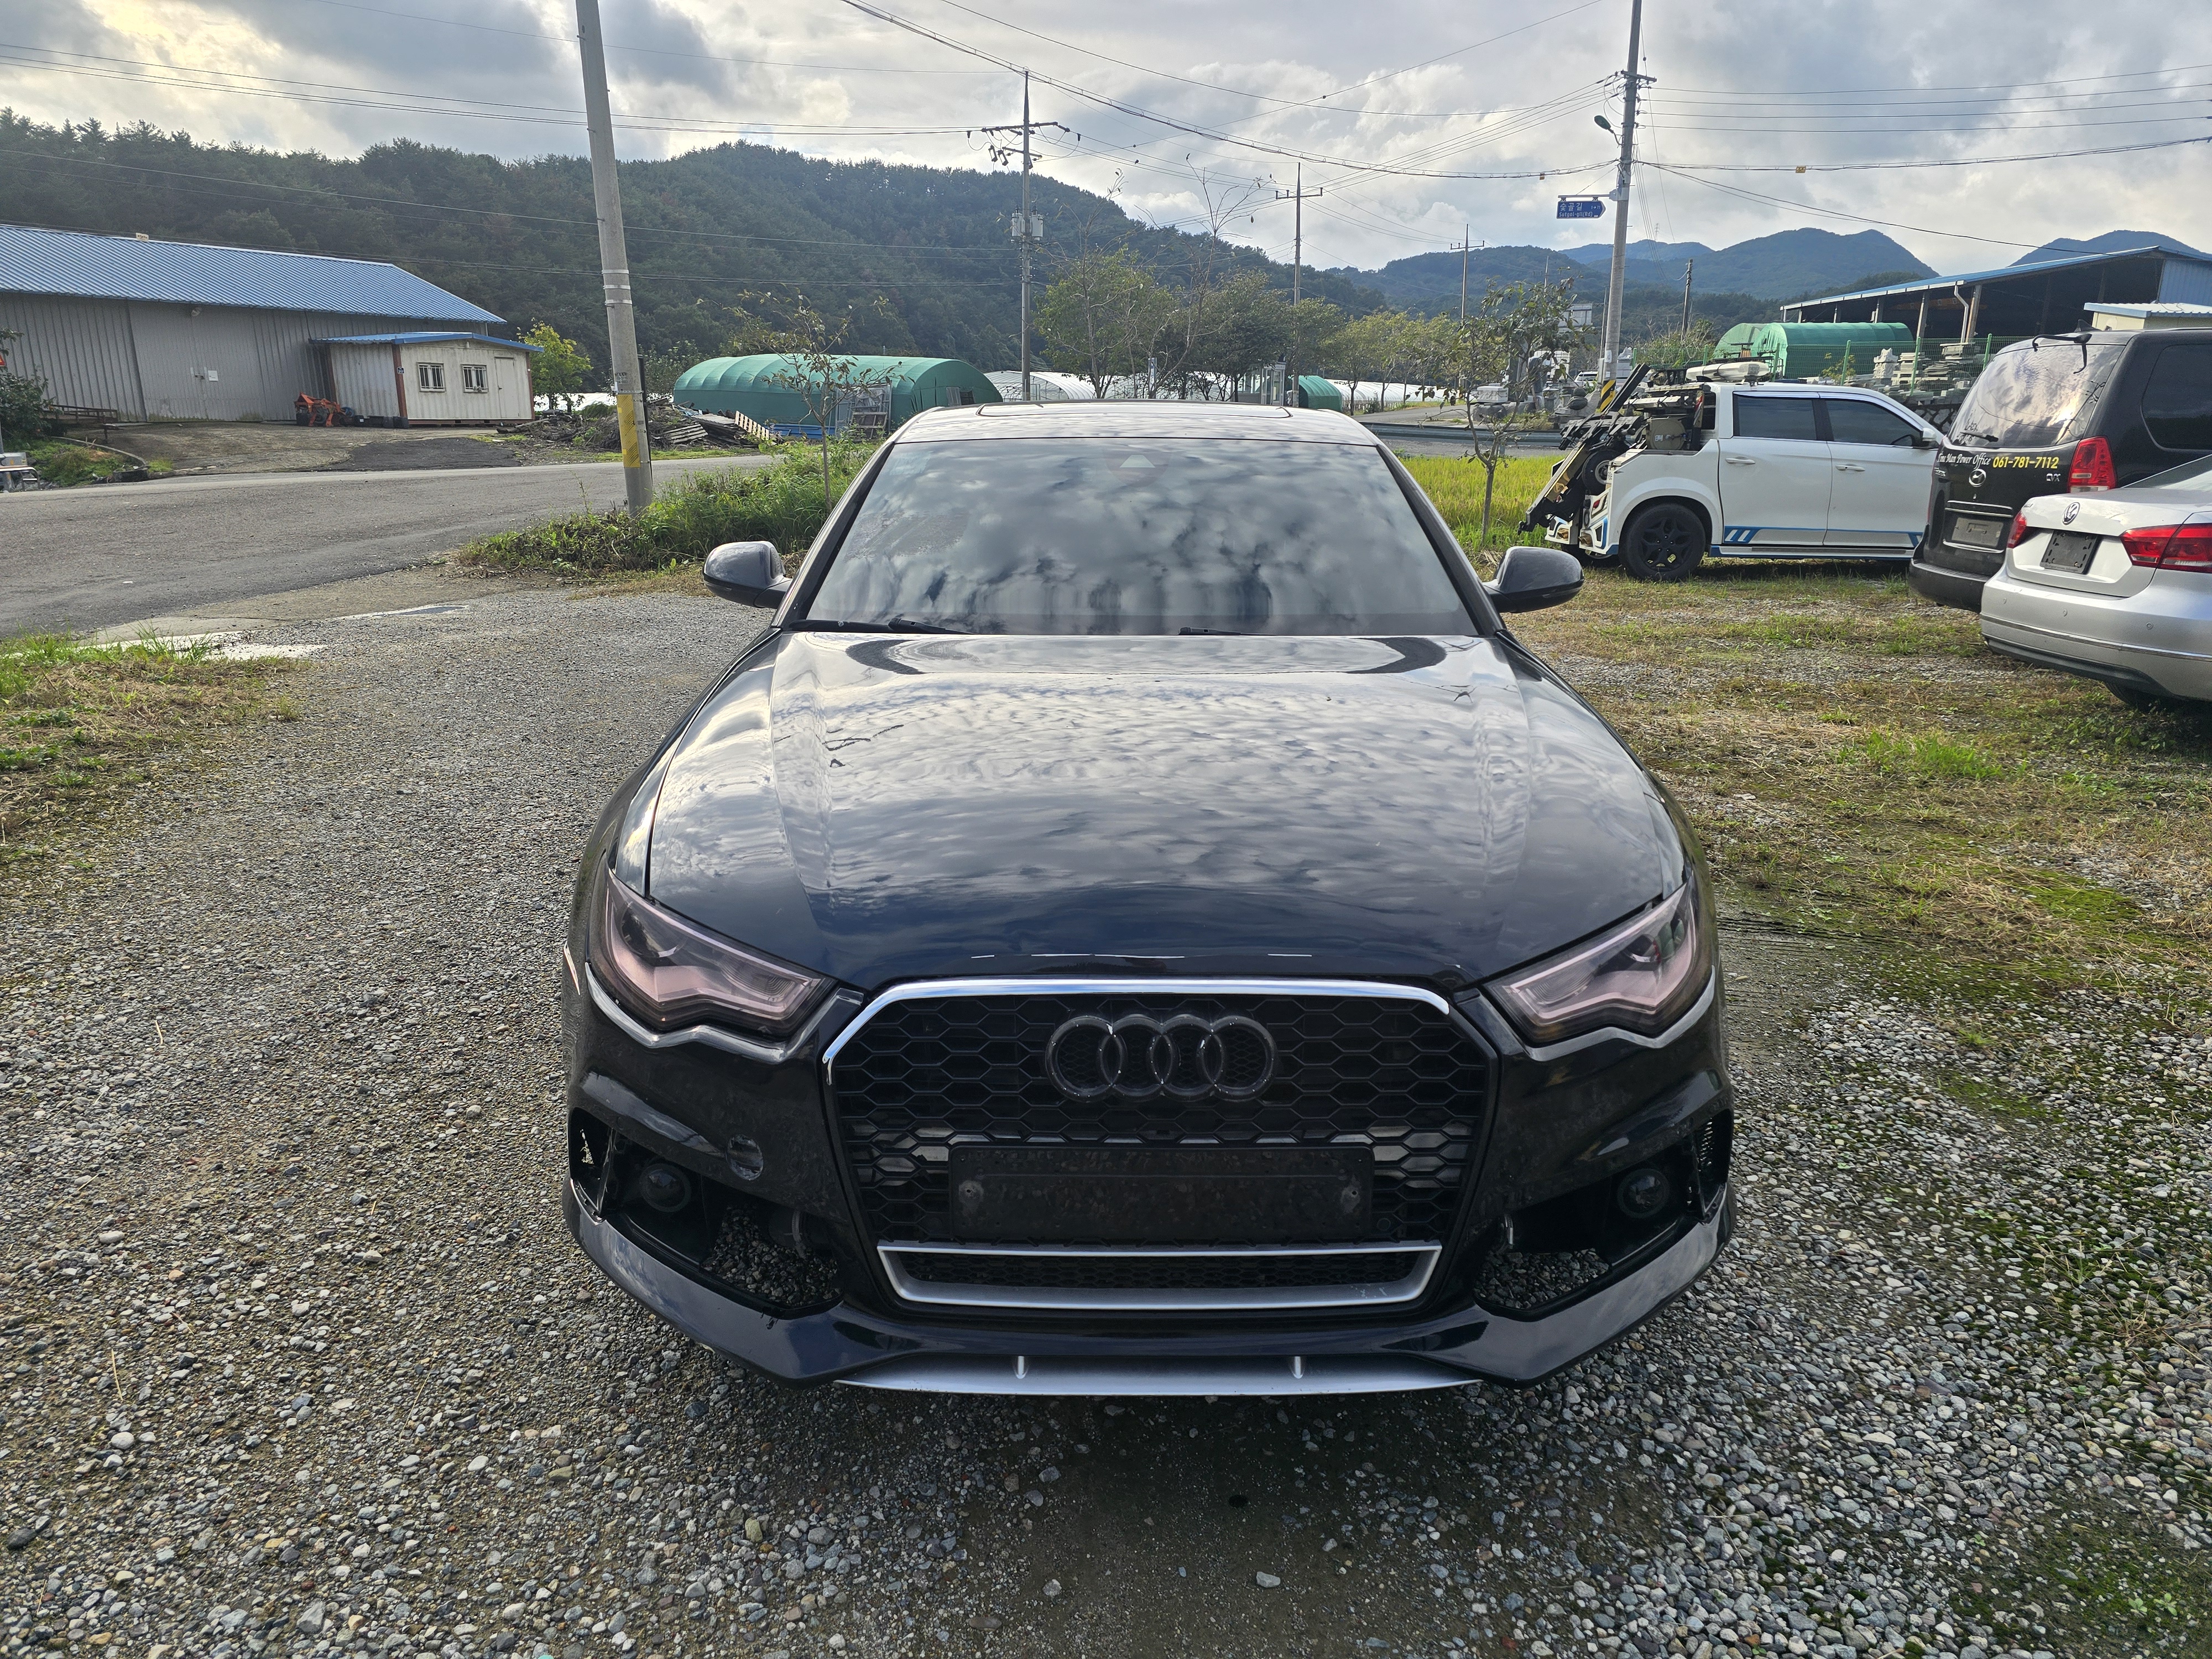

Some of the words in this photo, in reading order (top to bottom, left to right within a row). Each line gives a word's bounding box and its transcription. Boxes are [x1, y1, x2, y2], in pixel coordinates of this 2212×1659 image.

[1957, 453, 1973, 464] Power
[1973, 452, 1991, 469] Office
[1992, 456, 2059, 469] 061-781-7112
